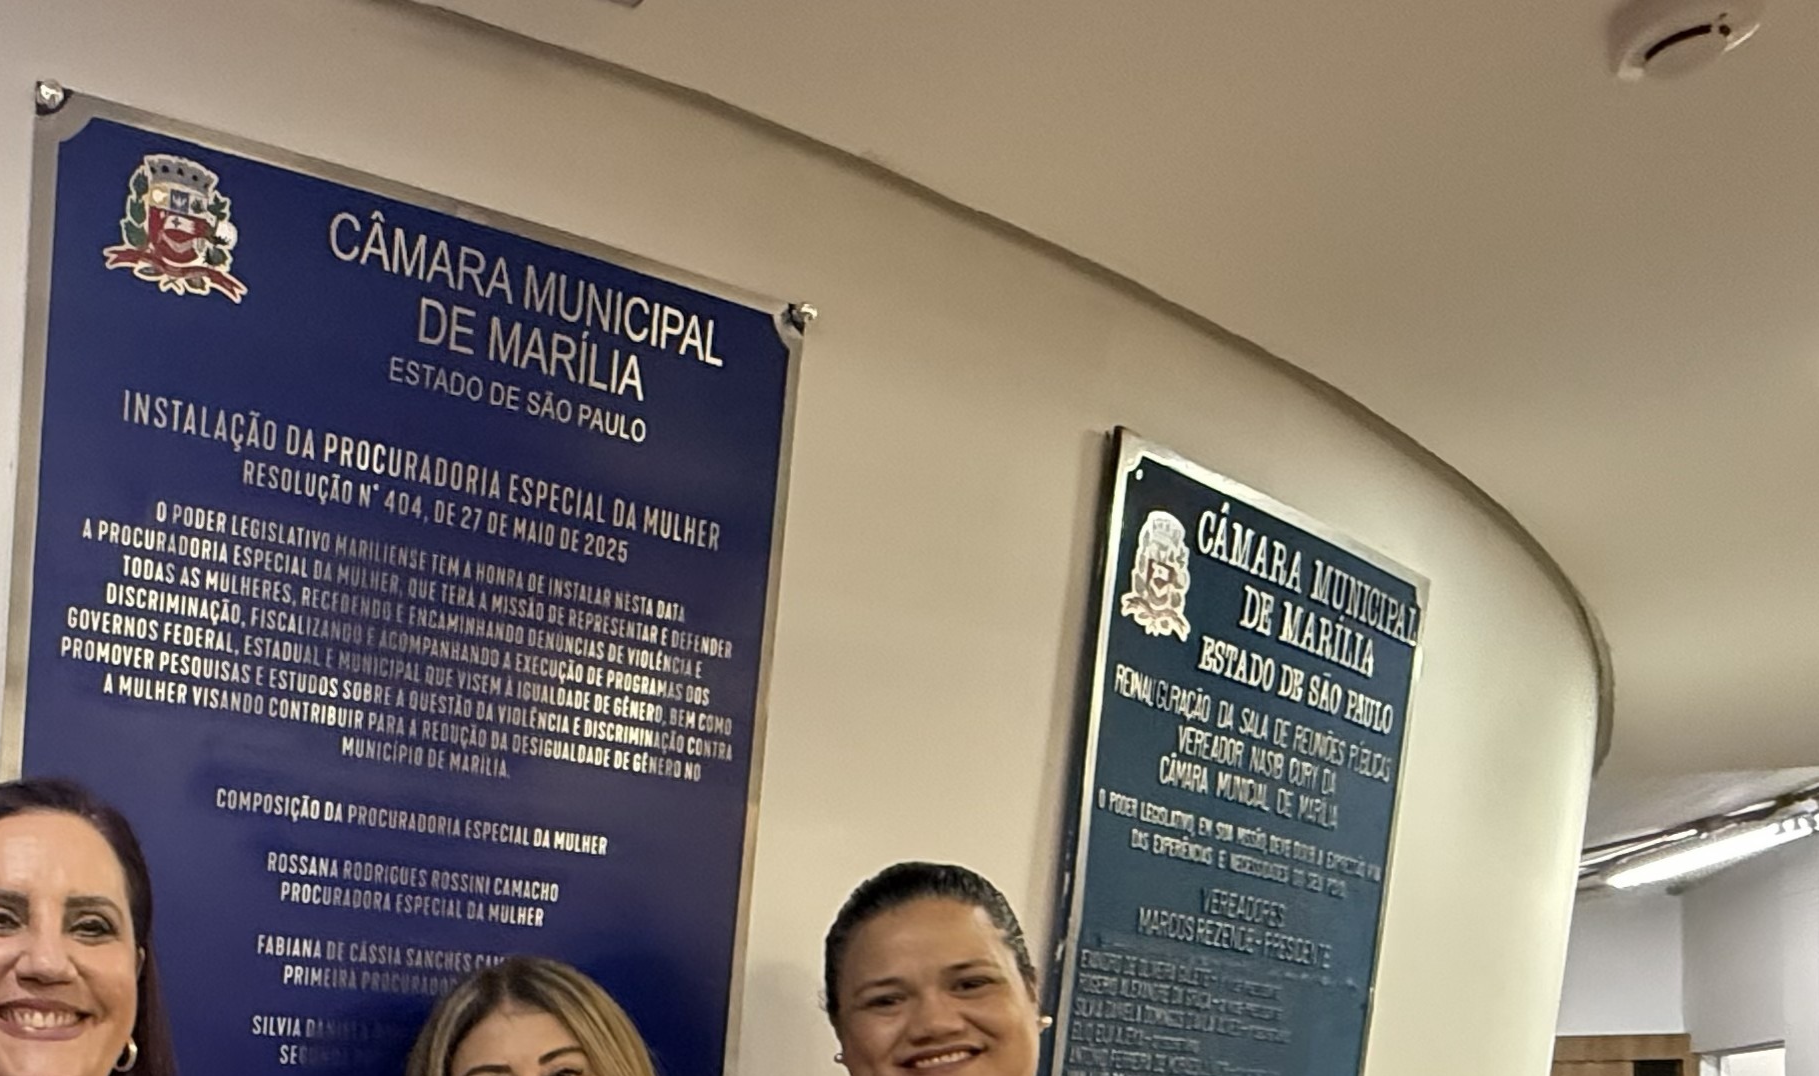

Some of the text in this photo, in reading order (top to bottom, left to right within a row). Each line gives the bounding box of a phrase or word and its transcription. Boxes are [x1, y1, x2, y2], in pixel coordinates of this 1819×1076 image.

[329, 210, 723, 367] CÂMARA MUNICIPAL
[417, 297, 644, 401] DE MARÍLIA
[389, 357, 646, 443] ESTADO DE SÃO PAULO
[123, 389, 720, 551] INSTALAÇÃO DA PROCURADORIA ESPECIAL DA MULHER
[172, 503, 330, 552] PODER LEGISLATIVO
[243, 460, 629, 563] RESOLUÇÃO 404, DE 27 DE MAIO DE 2025
[98, 520, 308, 579] PROCURADORIA ESPECIAL
[1197, 502, 1417, 647] CÂMARA MUNICIPAL
[123, 554, 297, 606] TODAS MULHERES,
[67, 606, 321, 668] GOVERNOS FEDERAL, ESTADUAL
[1239, 584, 1375, 678] DE MARÍLIA
[61, 636, 732, 761] PROMOVER PESQUISAS ESTUDOS SOBRE QUESTÃO VIOLÊNCIA DISCRIMINAÇÃO CONTRA
[119, 676, 406, 736] MULHER VISANDO CONTRIBUIR PARA
[1198, 635, 1394, 735] ESTADO DE SÃO PAULO
[1178, 725, 1244, 768] VEREADOR
[1217, 699, 1234, 730] DA
[1238, 708, 1268, 741] SALA
[1273, 717, 1291, 748] DE
[342, 736, 510, 779] MUNICÍPIO DE MARÍLIA.
[1159, 752, 1209, 794] CÂMARA
[217, 788, 608, 856] COMPOSIÇÃO DA PROCURADORIA ESPECIAL DA MULHER
[267, 851, 559, 903] ROSSANA RODRIGUES ROSSINI CAMACHO
[281, 881, 544, 927] PROCURADORA ESPECIAL DA MULHER
[257, 934, 321, 958] FABIANA
[283, 964, 357, 989] PRIMEIRA
[252, 1015, 301, 1037] SILVIA
